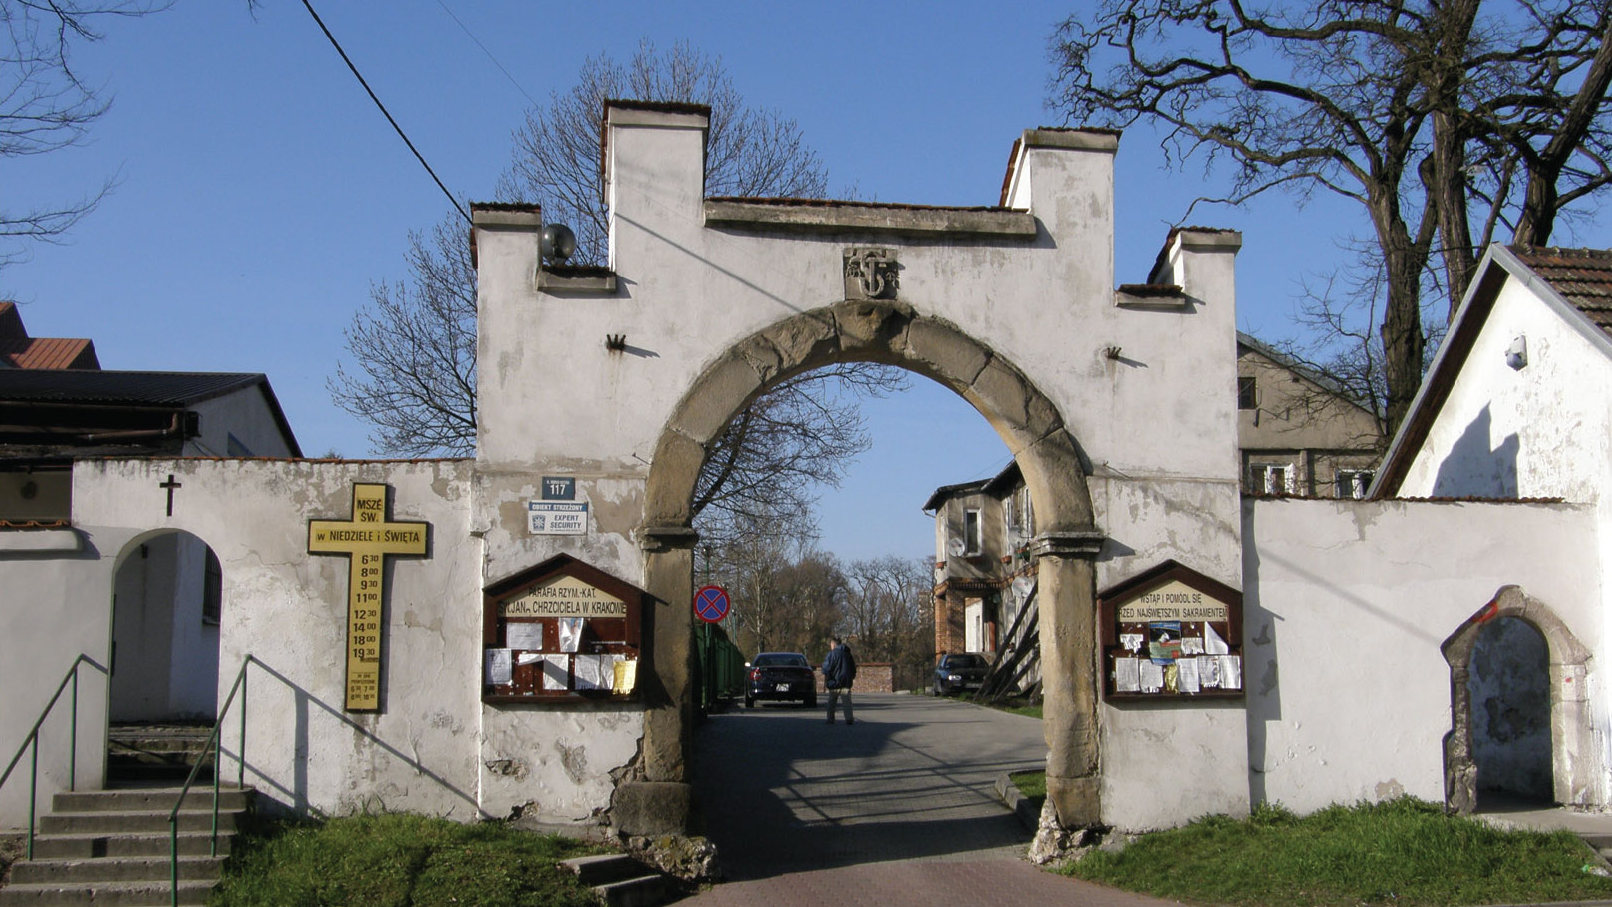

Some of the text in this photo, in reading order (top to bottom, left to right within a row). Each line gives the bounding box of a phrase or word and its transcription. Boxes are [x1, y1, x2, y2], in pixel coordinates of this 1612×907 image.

[550, 484, 566, 496] 117
[554, 514, 580, 522] EXPERT
[550, 521, 582, 529] SECURITY
[330, 530, 373, 542] NIEDZIELE
[384, 529, 420, 545] ŚWIĘTA
[528, 586, 558, 598] PARAFIA
[532, 600, 581, 614] CHRZCICIELA
[582, 601, 590, 614] W
